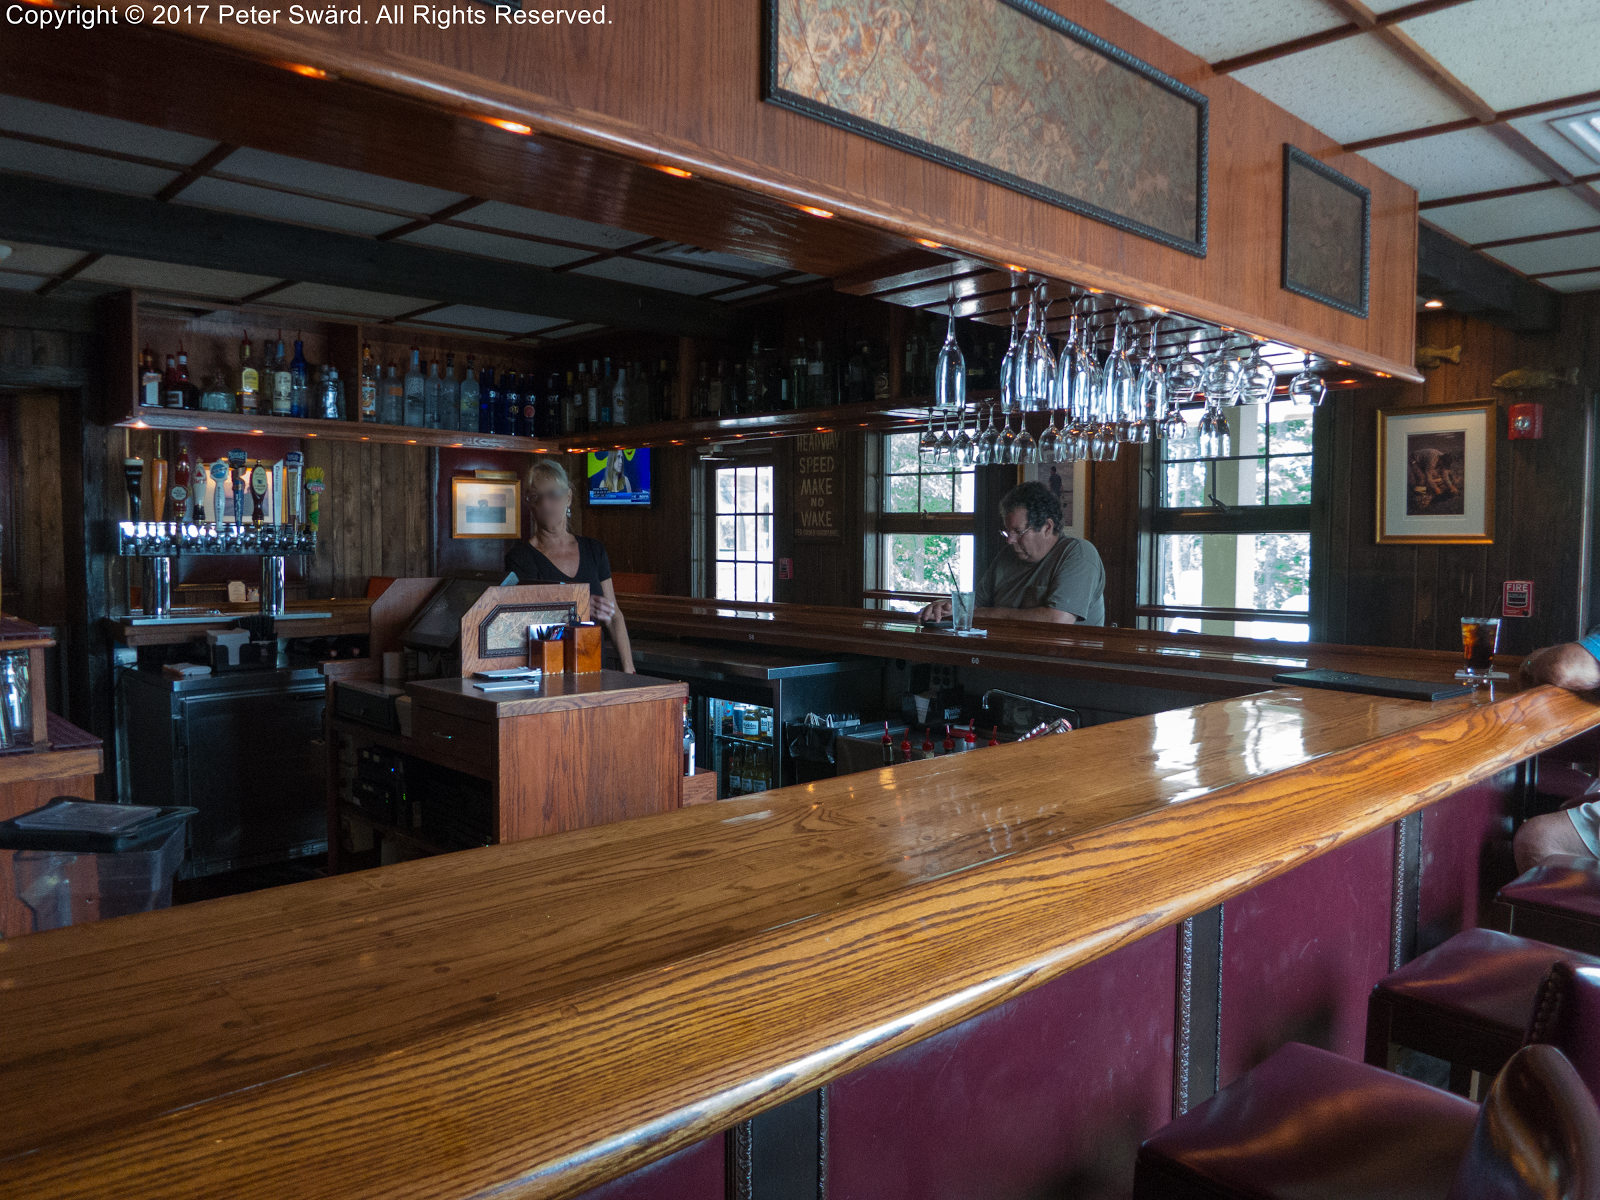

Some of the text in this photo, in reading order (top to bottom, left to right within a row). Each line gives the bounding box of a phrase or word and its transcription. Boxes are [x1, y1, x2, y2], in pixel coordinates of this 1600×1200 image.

[797, 432, 840, 452] HEADWAY
[799, 456, 835, 474] SPEED
[800, 478, 833, 496] MAKE
[810, 497, 825, 508] NO
[800, 511, 833, 527] WAKE
[1506, 583, 1529, 592] FIRE
